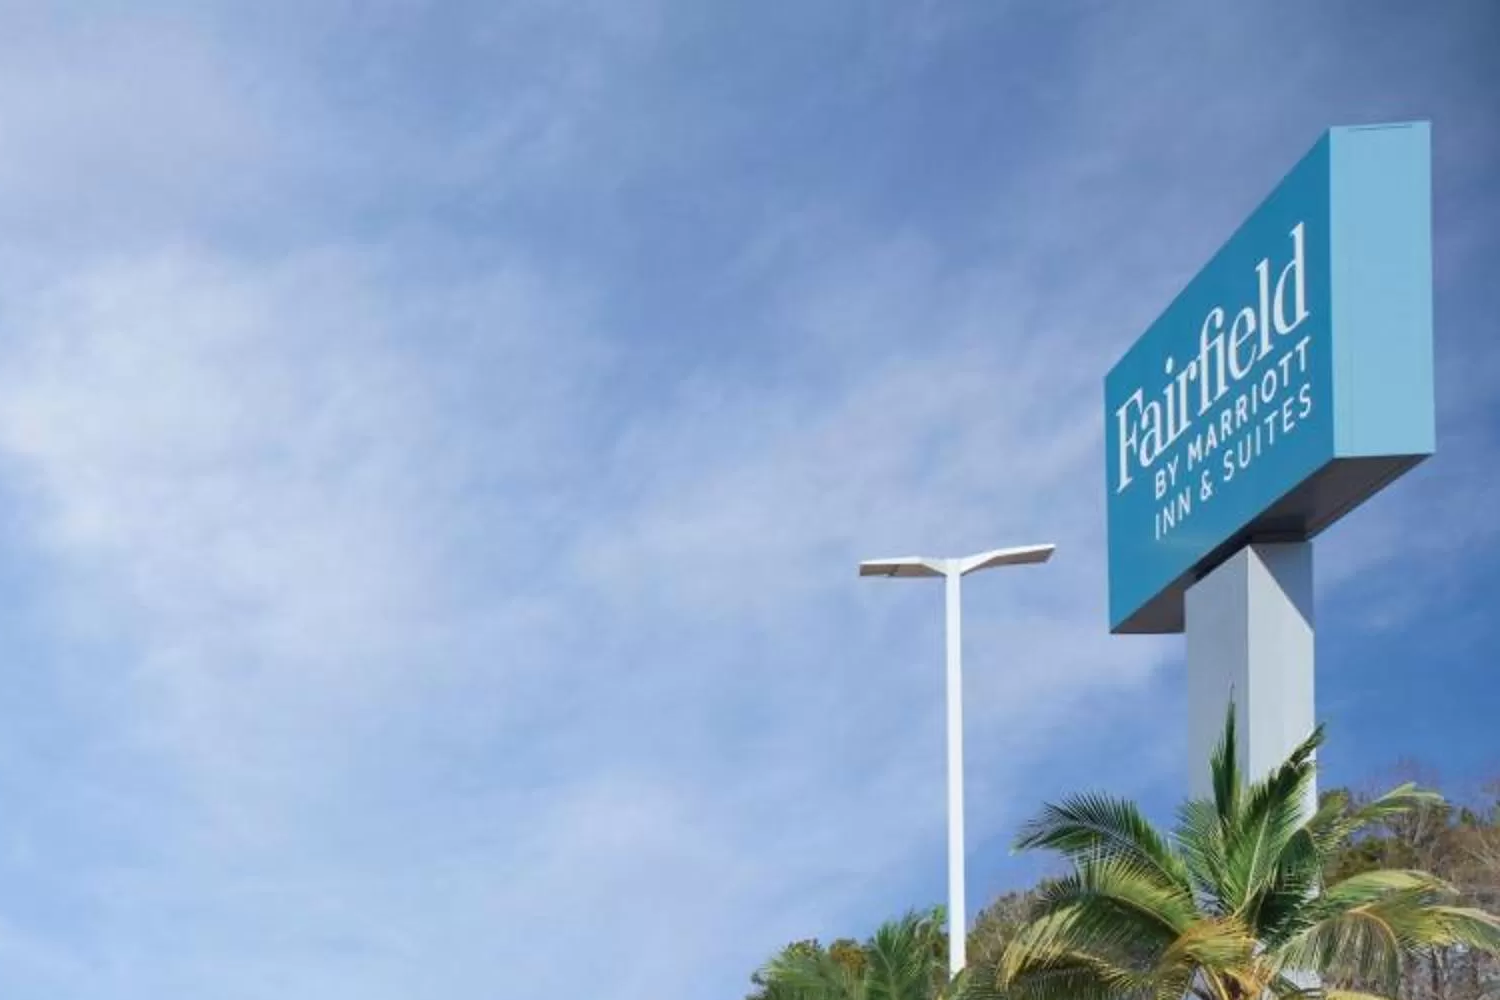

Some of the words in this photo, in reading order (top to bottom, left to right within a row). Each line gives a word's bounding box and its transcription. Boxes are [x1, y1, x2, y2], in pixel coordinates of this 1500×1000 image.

[1115, 221, 1311, 493] Fairfield
[1155, 455, 1180, 501] BY
[1187, 335, 1312, 471] MARRIOTT
[1154, 487, 1192, 541] INN
[1199, 469, 1213, 502] &
[1223, 383, 1312, 482] SUITES
